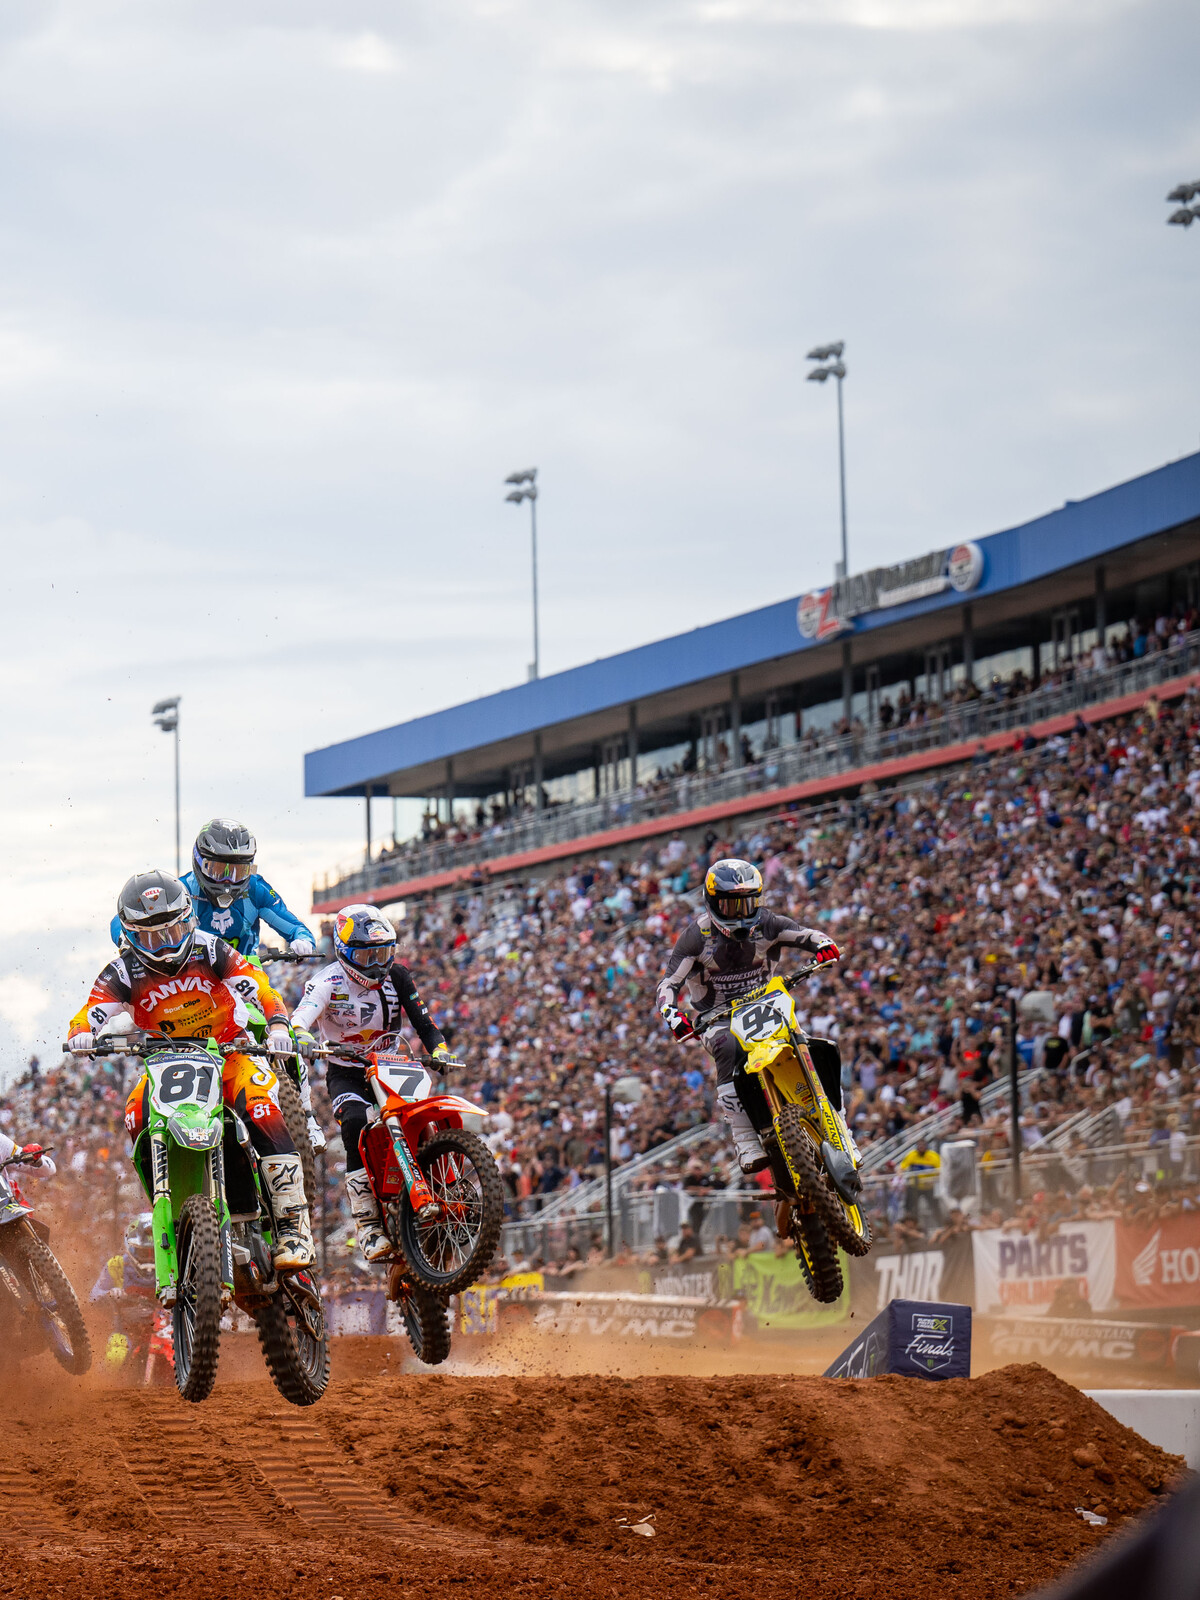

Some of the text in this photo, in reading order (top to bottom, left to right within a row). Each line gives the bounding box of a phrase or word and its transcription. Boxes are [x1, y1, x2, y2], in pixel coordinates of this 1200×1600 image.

[235, 979, 255, 997] 81
[709, 966, 764, 982] PROGRESSIVE
[140, 976, 216, 1012] CANVAS
[91, 1006, 108, 1025] 81
[742, 1000, 784, 1041] 94
[159, 1063, 214, 1104] 81
[388, 1068, 424, 1097] 7
[253, 1103, 272, 1119] 81
[825, 1111, 841, 1151] DUNLOP
[225, 1229, 234, 1279] DUNLOP
[999, 1233, 1089, 1279] PARTS
[0, 1265, 21, 1299] DUNLOP
[874, 1250, 947, 1311] THOR
[905, 1333, 955, 1357] Finals
